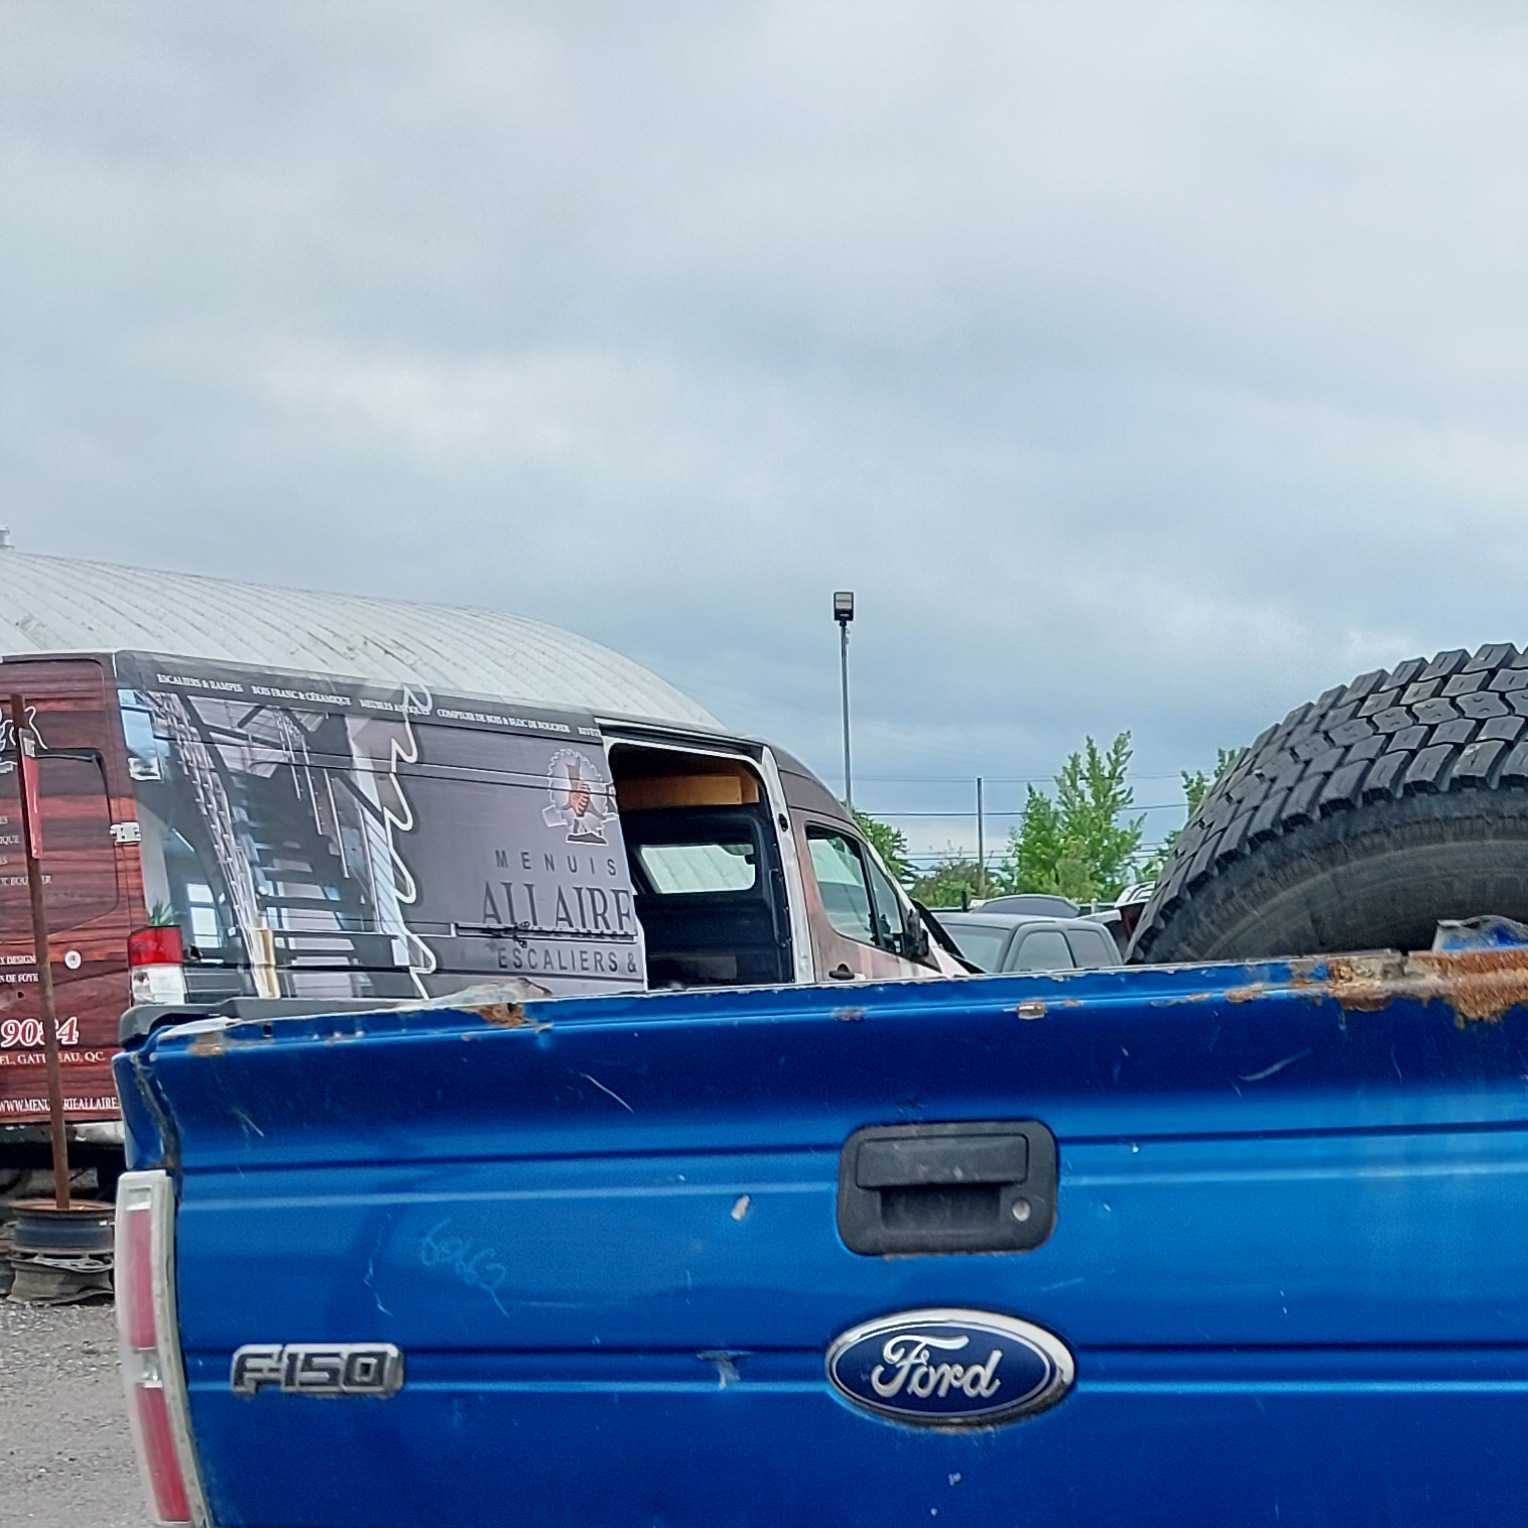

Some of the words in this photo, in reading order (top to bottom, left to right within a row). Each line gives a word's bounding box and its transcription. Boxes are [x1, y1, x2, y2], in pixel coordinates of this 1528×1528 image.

[496, 850, 617, 876] MENUIS
[498, 948, 618, 972] ESCALIERS
[0, 1016, 79, 1048] 904
[18, 1051, 83, 1064] GATIEAU,
[84, 1051, 106, 1062] QC
[871, 1335, 1003, 1398] Ford
